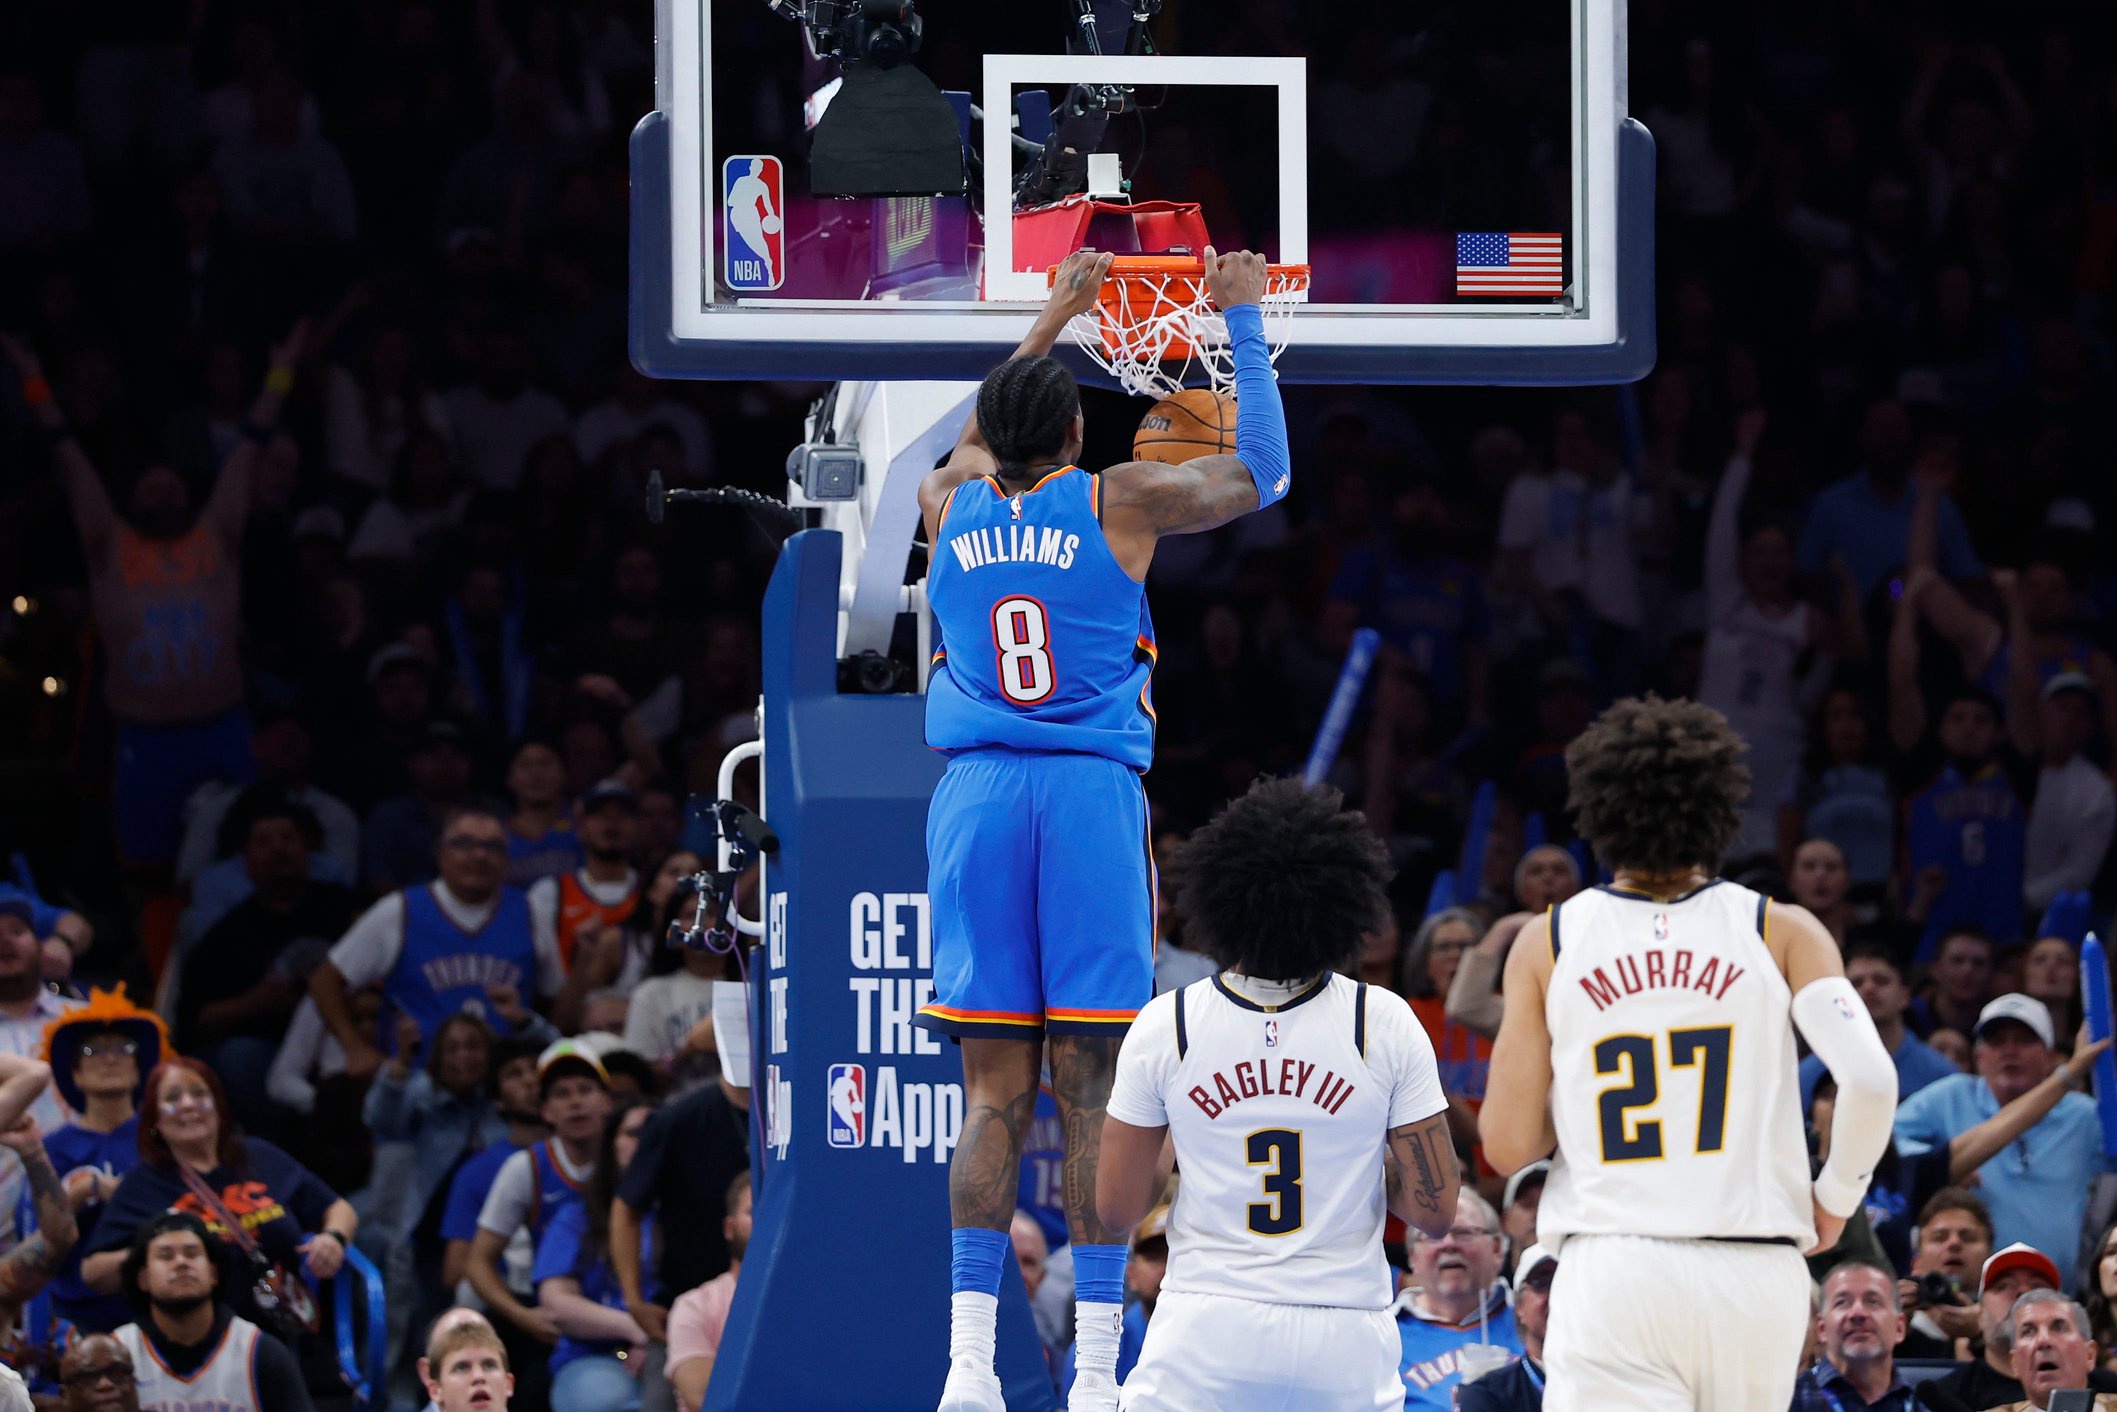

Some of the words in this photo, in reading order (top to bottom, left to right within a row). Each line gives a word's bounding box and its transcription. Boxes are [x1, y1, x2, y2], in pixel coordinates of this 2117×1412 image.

[734, 260, 762, 281] NBA
[950, 525, 1080, 573] WILLIAMS
[990, 594, 1058, 706] 8
[850, 891, 932, 970] GET
[850, 978, 941, 1055] THE
[1578, 950, 1745, 1012] MURRAY
[871, 1066, 963, 1164] App
[1188, 1058, 1315, 1120] BAGLEY
[1313, 1071, 1355, 1115] III
[1592, 1023, 1735, 1164] 27
[1245, 1127, 1304, 1237] 3
